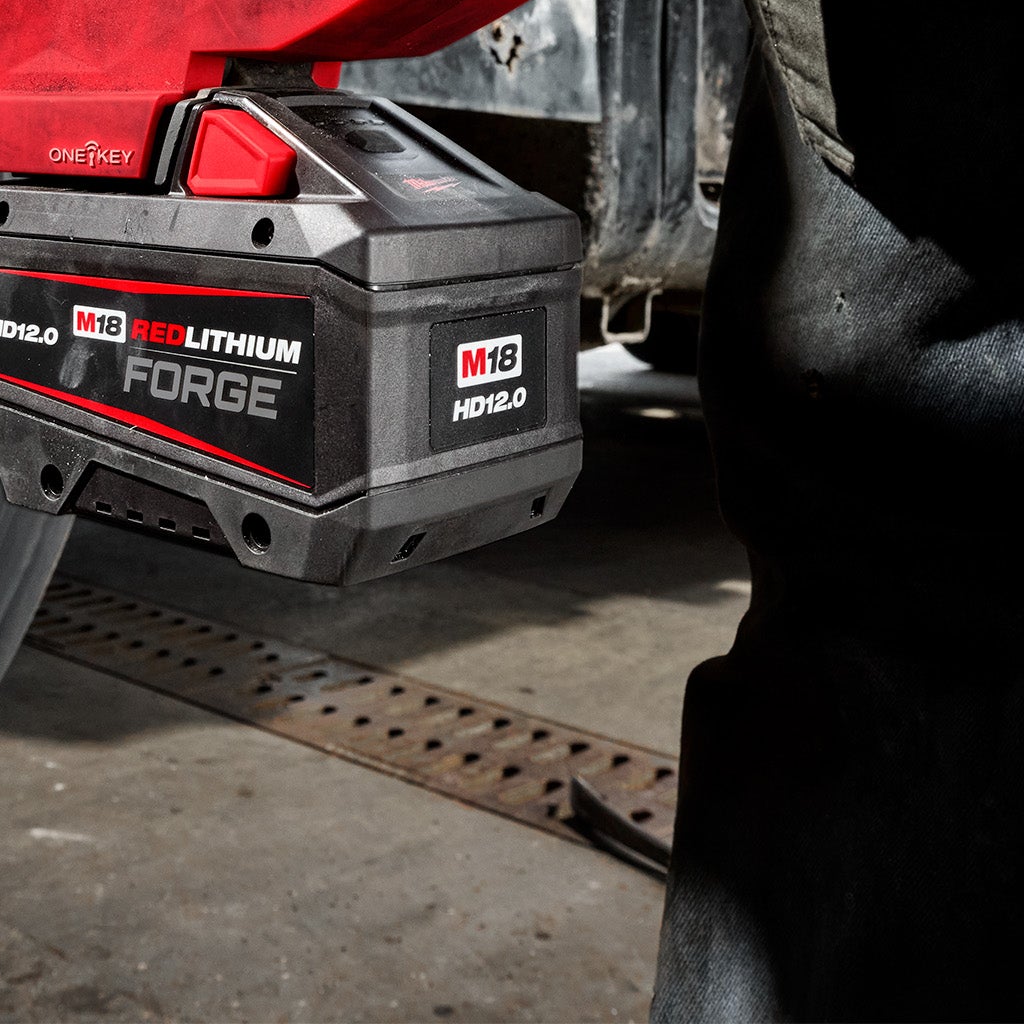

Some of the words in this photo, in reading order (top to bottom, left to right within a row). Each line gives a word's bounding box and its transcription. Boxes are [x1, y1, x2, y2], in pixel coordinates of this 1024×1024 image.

[76, 310, 123, 338] M18
[131, 318, 302, 365] REDLITHIUM
[461, 342, 519, 379] M18
[123, 355, 282, 420] FORGE
[452, 387, 527, 422] HD12.0
